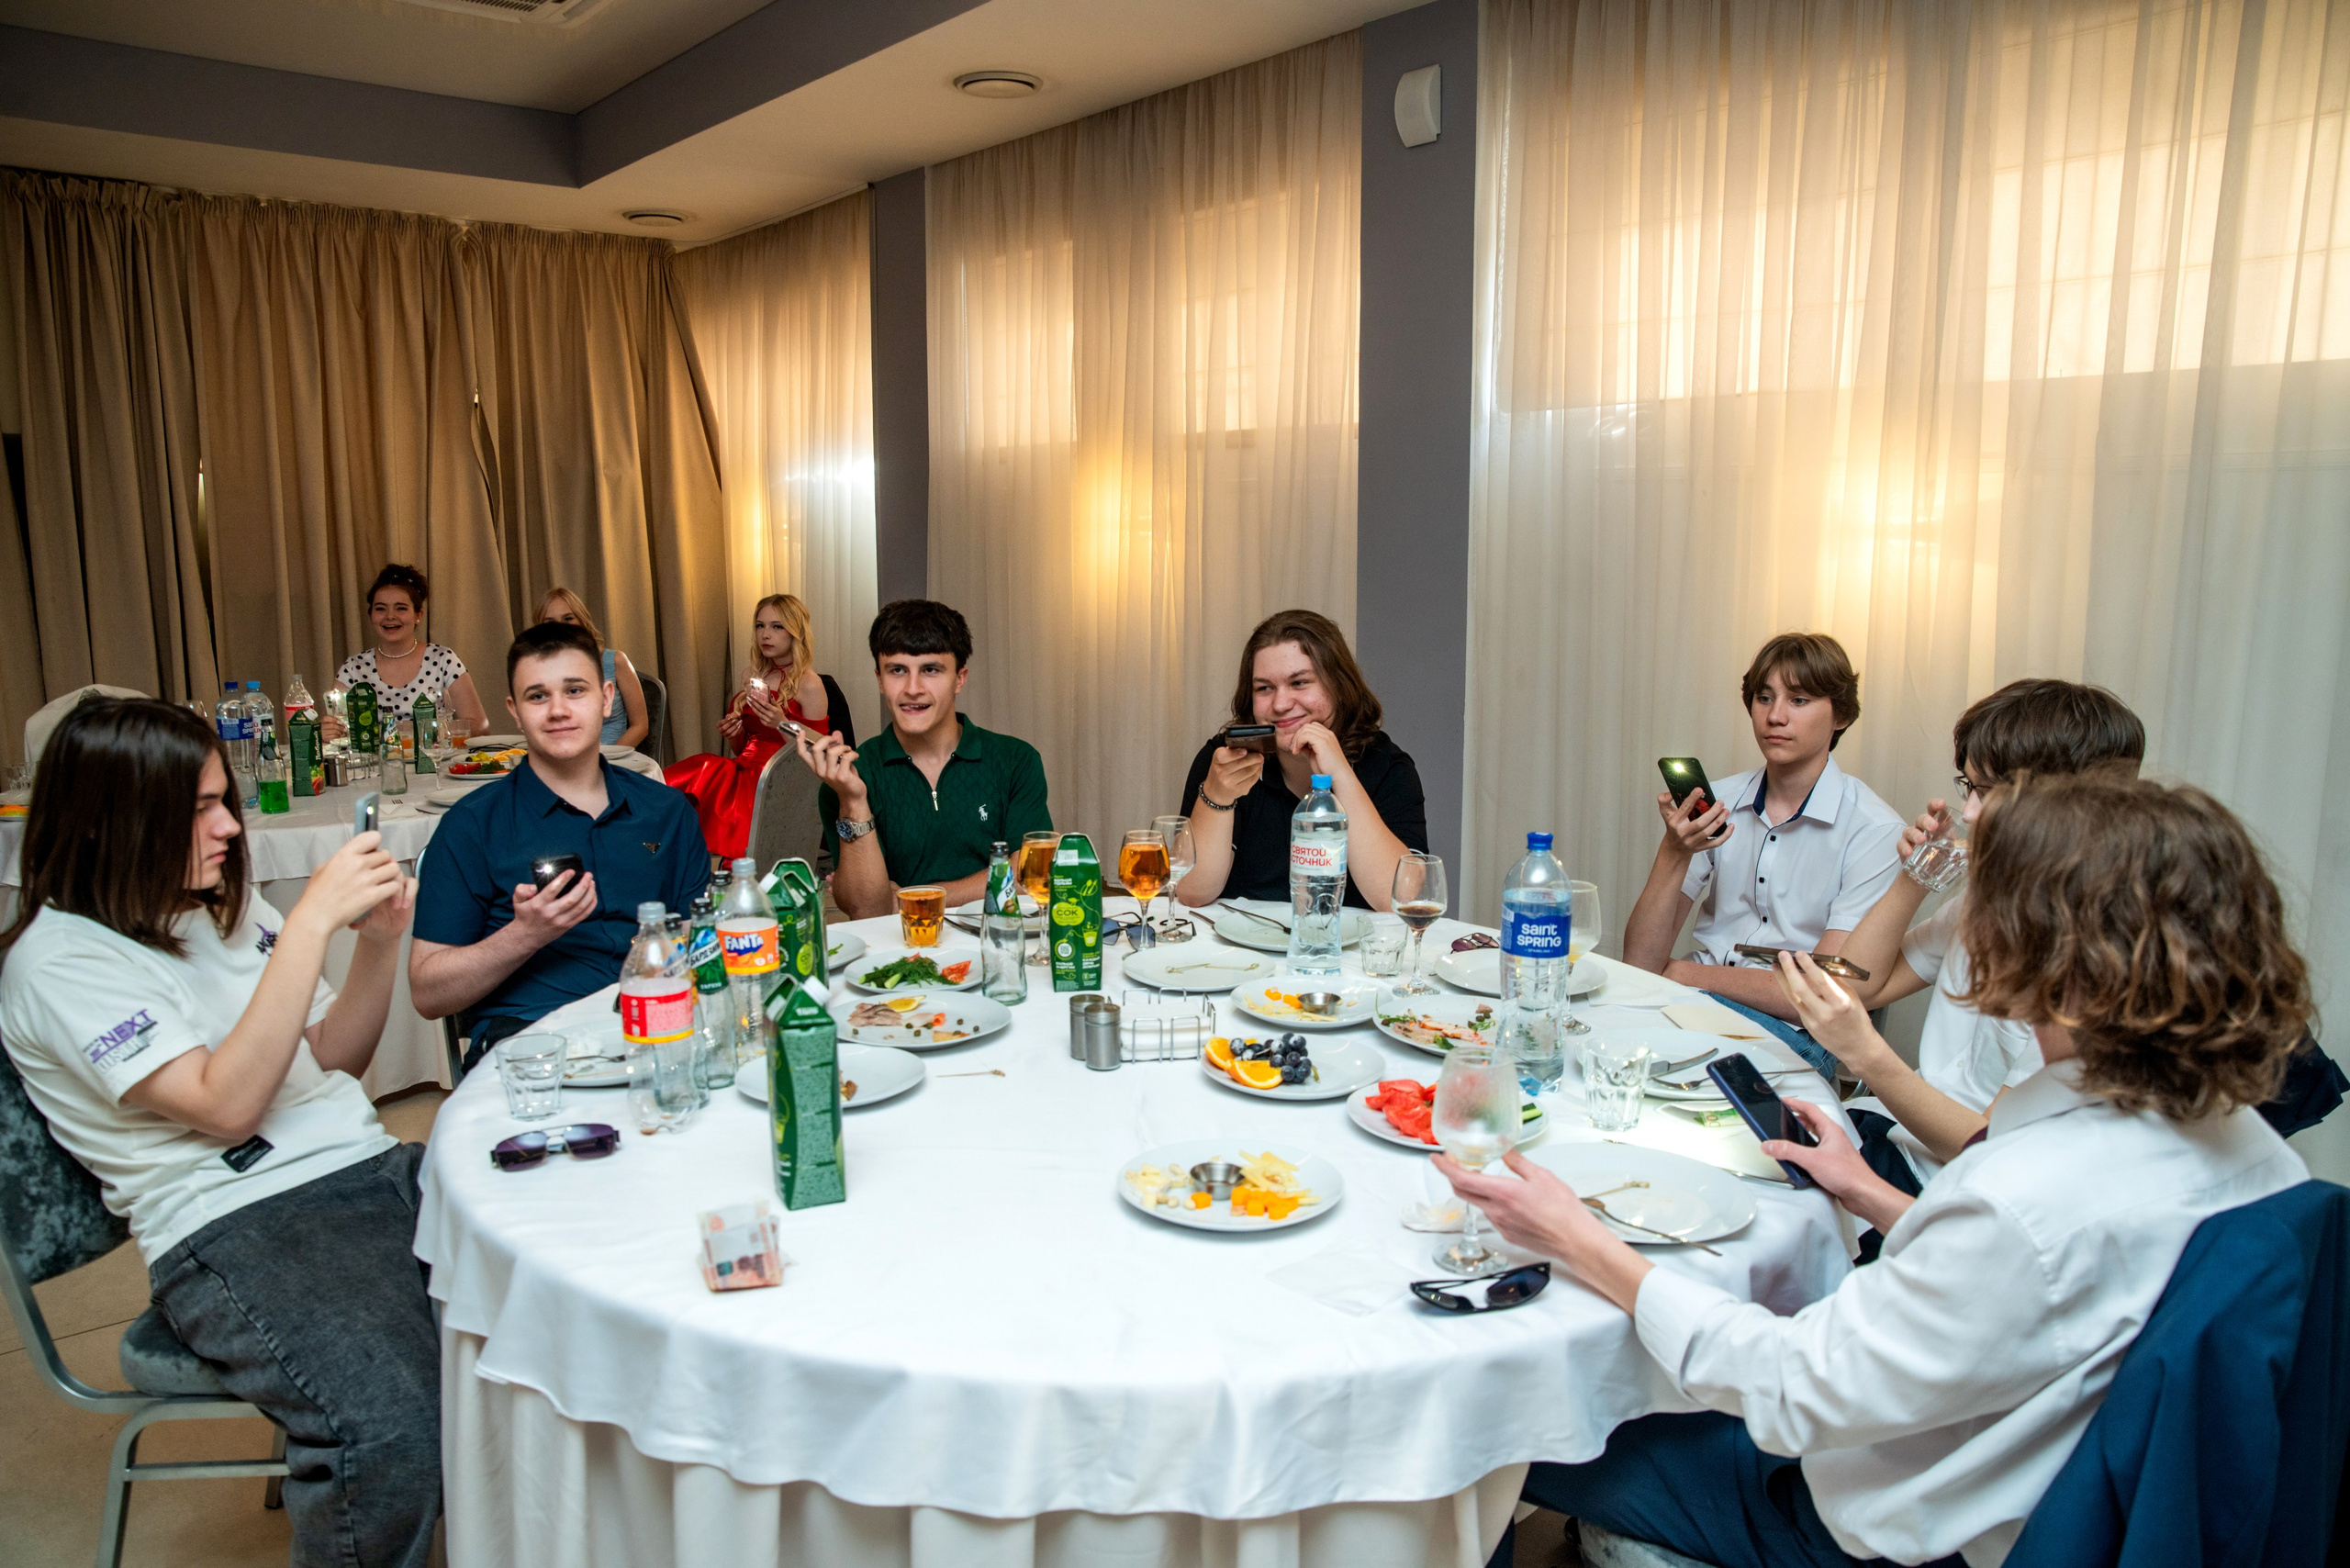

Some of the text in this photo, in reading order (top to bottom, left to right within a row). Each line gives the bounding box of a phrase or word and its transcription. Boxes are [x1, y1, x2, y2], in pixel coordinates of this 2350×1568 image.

[1291, 854, 1332, 867] СТОЧНИК
[1056, 909, 1079, 917] СОК
[723, 933, 764, 951] FANTA
[99, 1009, 153, 1047] NEXT
